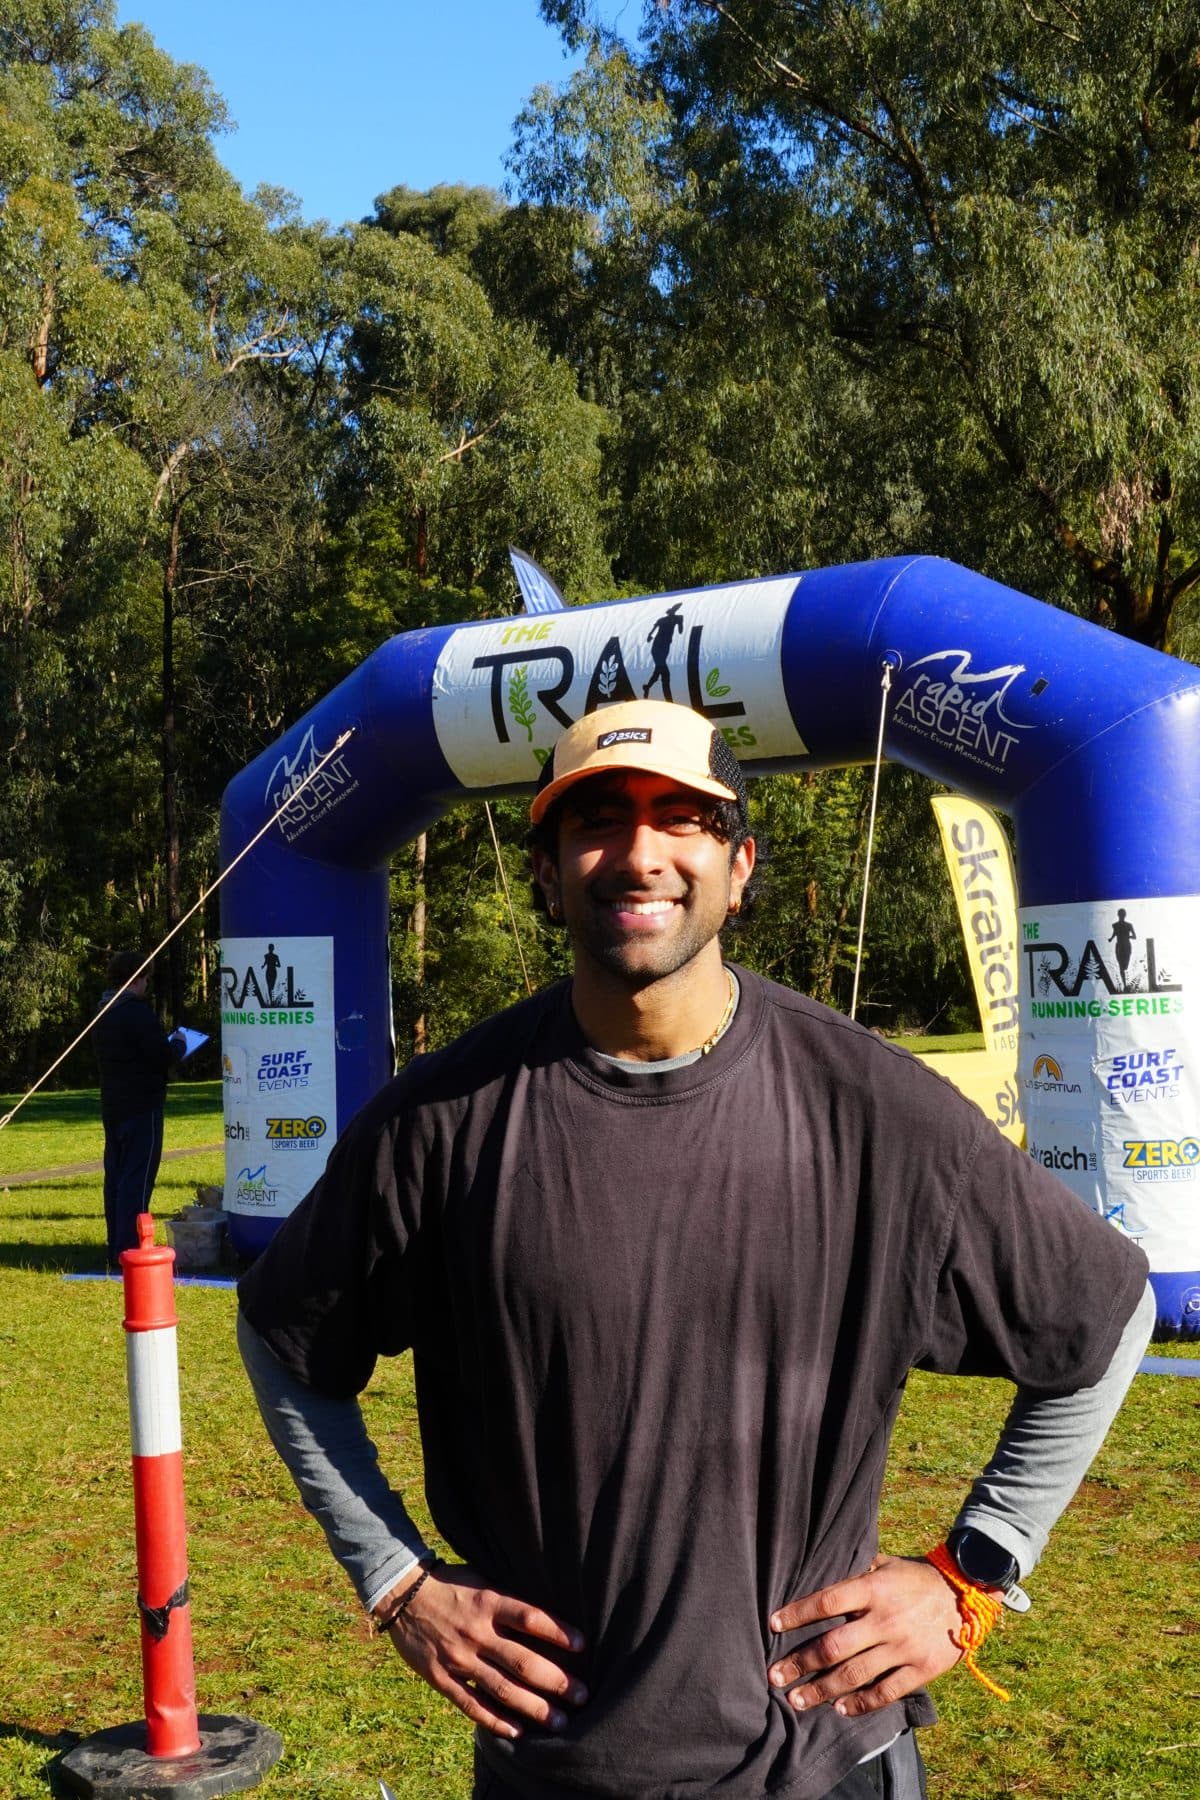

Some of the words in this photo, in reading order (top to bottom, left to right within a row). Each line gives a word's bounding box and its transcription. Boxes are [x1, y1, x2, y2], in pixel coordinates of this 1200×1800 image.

[502, 620, 555, 645] THE
[913, 673, 1001, 722] rapid
[616, 731, 648, 741] asics
[895, 688, 1019, 763] ASCENT
[276, 754, 352, 834] ASCENT
[1023, 922, 1040, 940] THE
[1023, 908, 1183, 998] TRAIL
[220, 943, 314, 1009] RAIL
[261, 1050, 307, 1067] SURF
[1112, 1048, 1176, 1072] SURF
[257, 1062, 313, 1080] COAST
[1106, 1065, 1184, 1091] COAST
[258, 1077, 309, 1092] EVENTS
[1110, 1083, 1181, 1106] EVENTS
[266, 1116, 326, 1139] ZERO
[274, 1140, 298, 1149] SPORTS
[299, 1139, 316, 1149] BEER
[1123, 1137, 1200, 1168] ZERO
[1136, 1169, 1169, 1181] SPORTS
[1171, 1168, 1193, 1179] BEER
[236, 1187, 279, 1202] ASCENT
